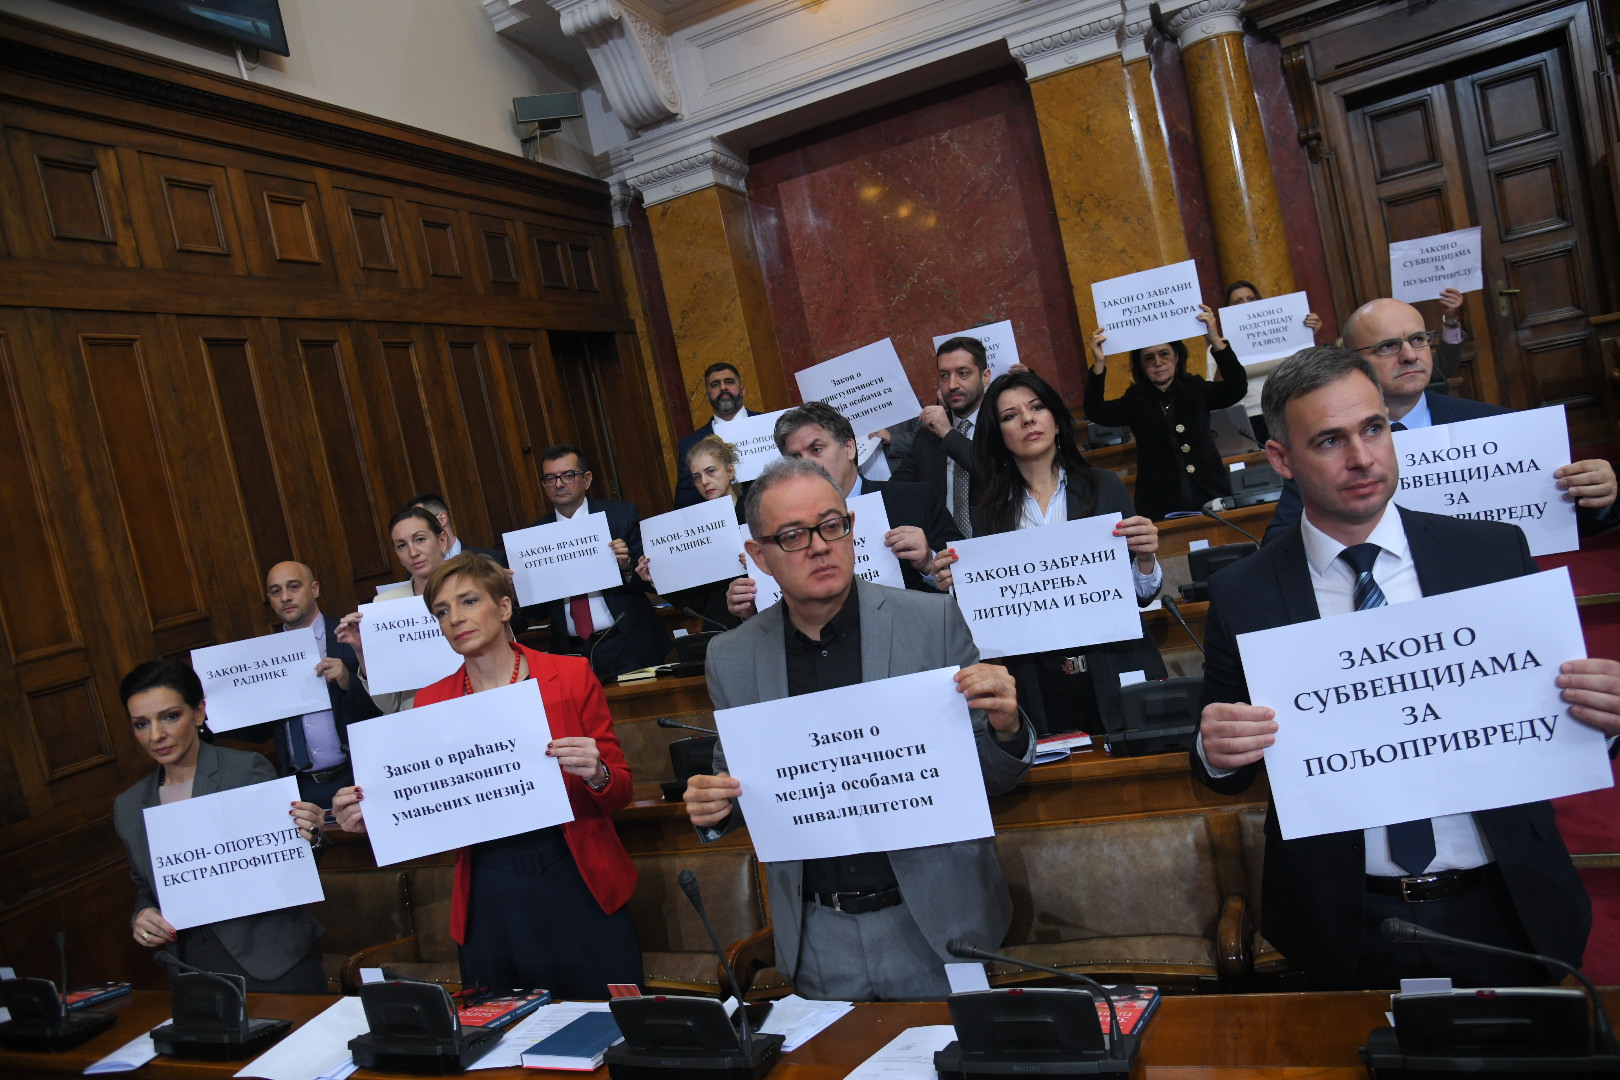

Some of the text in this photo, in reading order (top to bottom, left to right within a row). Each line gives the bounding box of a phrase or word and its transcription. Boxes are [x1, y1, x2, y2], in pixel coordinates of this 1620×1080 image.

[1402, 249, 1471, 268] СУБВЕНЦИЈАМА
[1419, 241, 1457, 255] ЗАКОН О
[1402, 267, 1473, 287] ПОЉОПРИВРЕДУ
[1101, 281, 1192, 309] ЗАКОН О ЗАБРАНИ
[1121, 298, 1175, 316] РУДАРЕЊА
[1105, 305, 1196, 331] ЛИТИЈУМА И БОРА
[1239, 314, 1294, 331] ПОДСТИЦАЈУ
[1247, 309, 1275, 320] ЗАКОН
[1246, 325, 1289, 341] РУРАЛНОГ
[1252, 336, 1287, 348] РАЗВОЈА
[831, 374, 855, 387] Закон
[849, 391, 882, 407] особама
[883, 387, 893, 395] са
[1405, 441, 1498, 467] ЗАКОН О
[1399, 458, 1541, 490] БВЕНЦИЈАМА
[1444, 491, 1470, 506] ЗА
[649, 519, 727, 547] ЗАКОН- ЗА НАШЕ
[669, 536, 712, 554] РАДНИКЕ
[518, 534, 600, 559] ЗАКОН- ВРАТИТЕ
[524, 547, 599, 569] ОТЕТЕ ПЕНЗИЈЕ
[964, 548, 1117, 584] ЗАКОН О ЗАБРАНИ
[998, 574, 1088, 599] РУДАРЕЊА
[972, 588, 1123, 621] ЛИТИЈУМА И БОРА
[373, 615, 437, 632] ЗАКОН- ЗА
[398, 628, 444, 643] РАДНИ
[1338, 626, 1477, 671] ЗАКОН О
[206, 651, 308, 680] ЗАКОН- ЗА НАШЕ
[233, 668, 288, 687] РАДНИКЕ
[1293, 649, 1543, 714] СУБВЕНЦИЈАМА
[1401, 702, 1442, 726] ЗА
[808, 725, 880, 748] Закон о
[1303, 714, 1560, 778] ПОЉОПРИВРЕДУ
[383, 737, 517, 779] Закон о враћању
[775, 743, 927, 781] приступачности
[393, 760, 521, 801] противзаконито
[774, 767, 940, 804] медија особама са
[391, 779, 536, 826] умањених пензија
[792, 794, 934, 826] инвалидитетом
[156, 827, 303, 869] ЗАКОН- ОПОРЕЗУЈТЕ
[163, 846, 306, 887] ЕКСТРАПРОФИТЕРЕ
